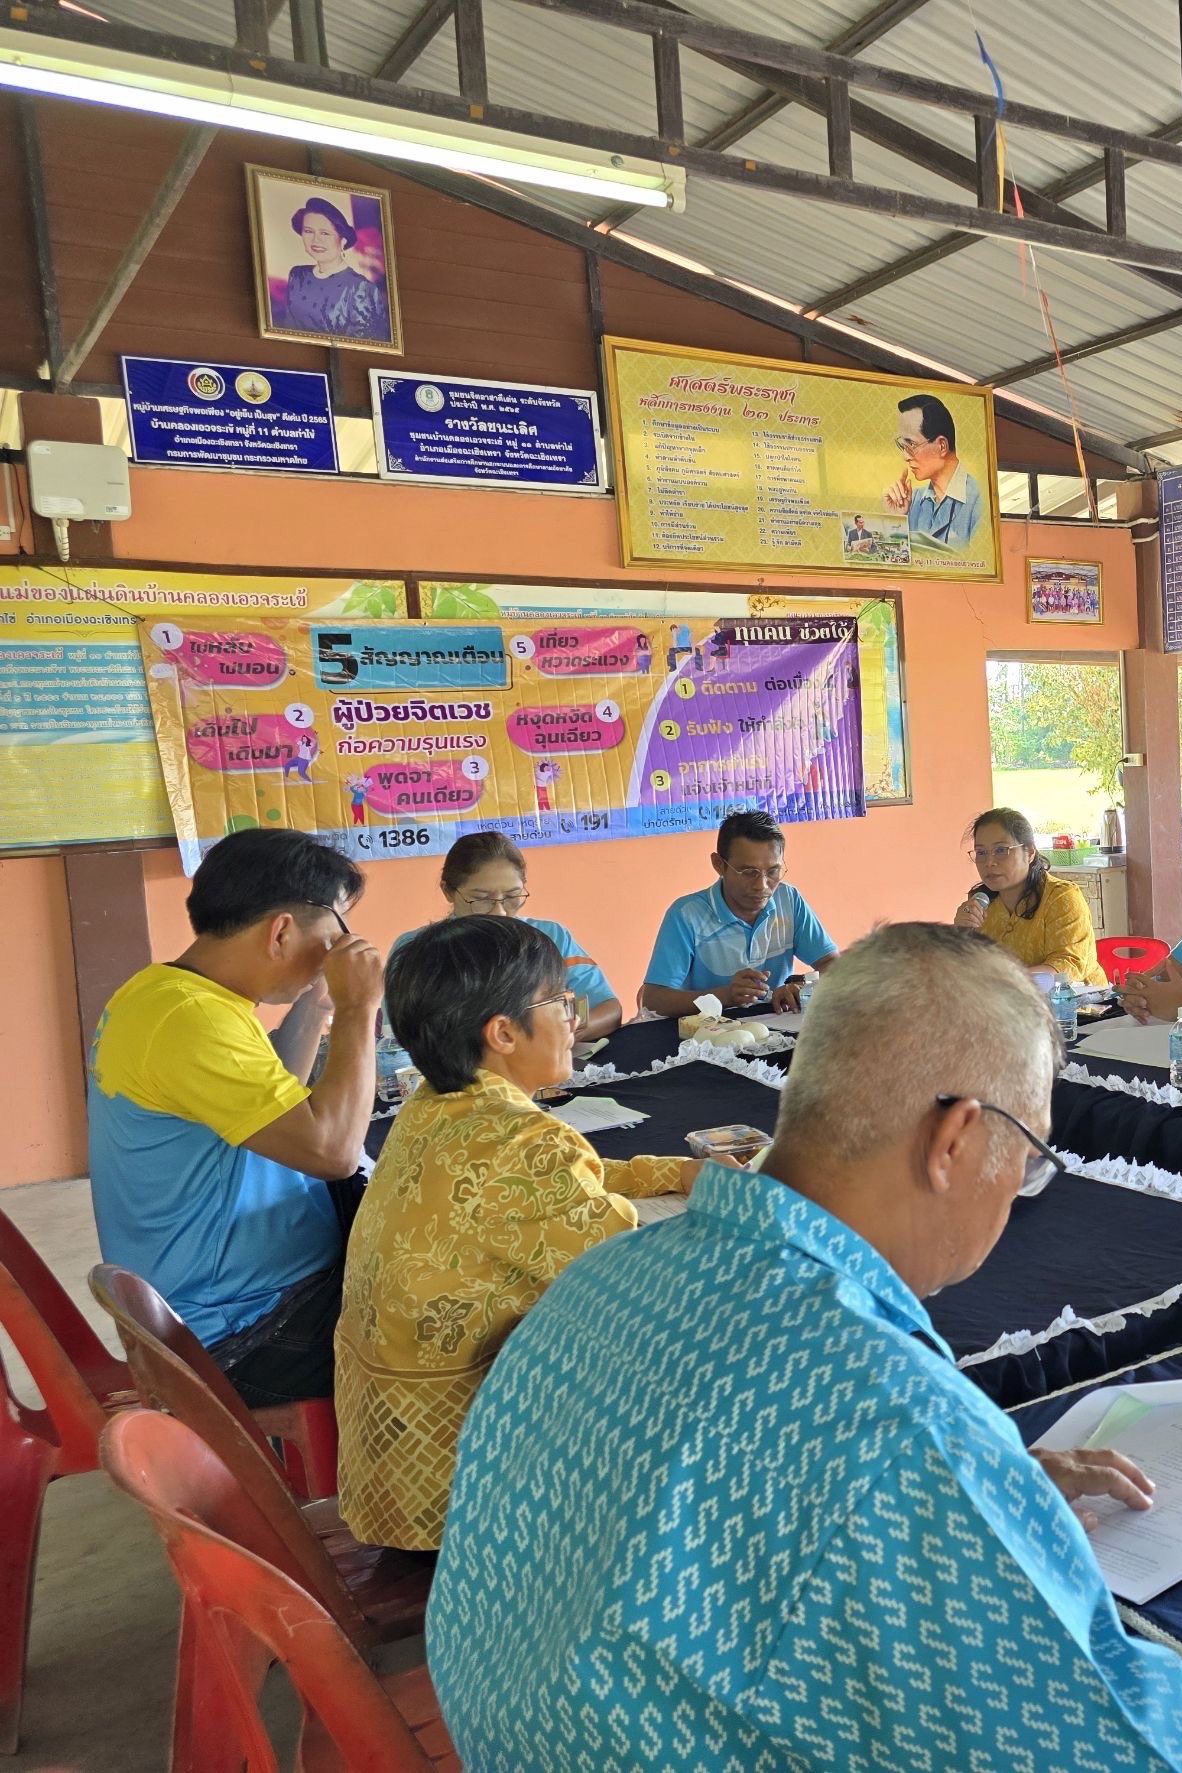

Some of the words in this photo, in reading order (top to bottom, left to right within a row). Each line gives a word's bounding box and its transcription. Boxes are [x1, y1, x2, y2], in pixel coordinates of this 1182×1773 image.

[309, 415, 328, 424] 2565
[445, 417, 538, 436] รางวัลชนะเลิศ
[258, 427, 269, 436] 11
[162, 631, 171, 643] 1
[735, 625, 792, 647] ทุกคน
[516, 641, 527, 654] 5
[317, 633, 359, 685] 5
[360, 645, 505, 667] สัญญาณเตือน
[541, 655, 630, 669] หวาดระแวง
[294, 710, 304, 722] 2
[334, 700, 491, 731] ผู้ป่วยจิตเวช
[516, 708, 593, 730] หงุดหงิด
[602, 705, 613, 718] 4
[534, 727, 602, 746] ฉุนเฉียว
[665, 725, 675, 736] 2
[338, 736, 488, 756] ก่อความรุนแรง
[470, 762, 480, 775] 3
[378, 770, 432, 790] พูดจา
[655, 775, 665, 786] 3
[397, 788, 474, 806] คนเดียว
[580, 812, 609, 831] 191
[378, 828, 430, 848] 1386
